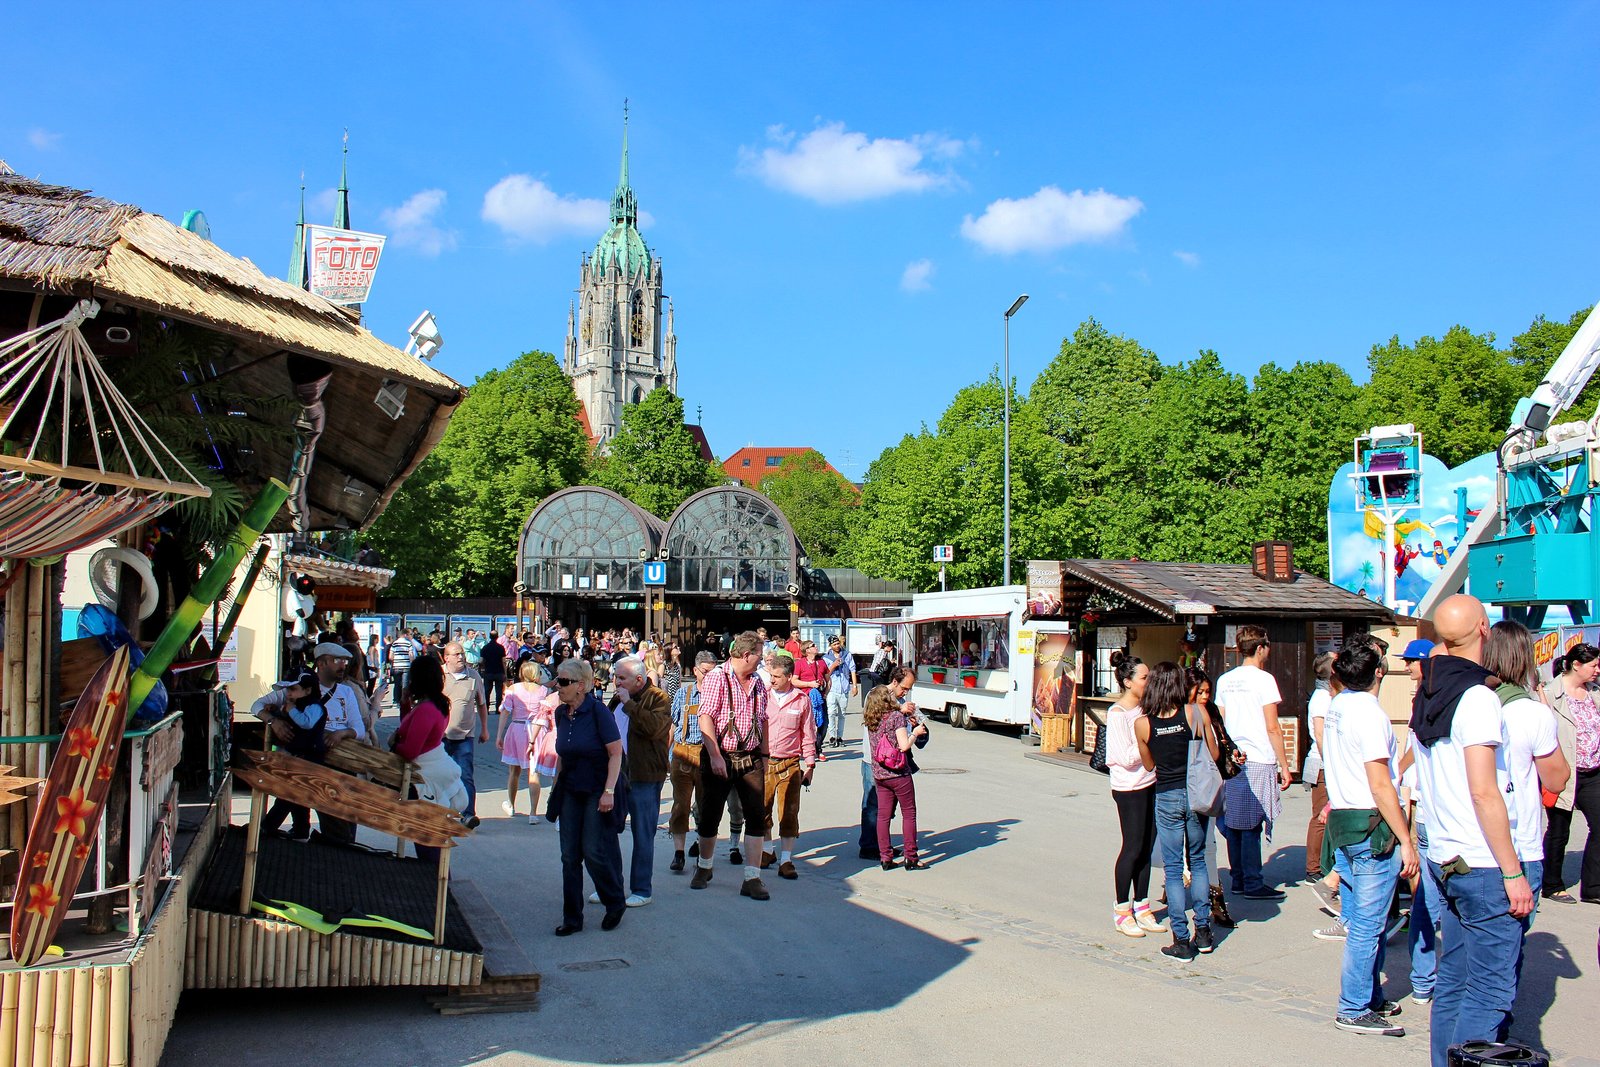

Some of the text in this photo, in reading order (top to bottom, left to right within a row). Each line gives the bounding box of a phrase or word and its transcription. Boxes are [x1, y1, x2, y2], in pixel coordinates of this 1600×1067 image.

[314, 246, 380, 270] FOTO
[313, 270, 373, 288] SCHIESSEN
[648, 565, 661, 581] U
[1533, 631, 1559, 667] FLIP
